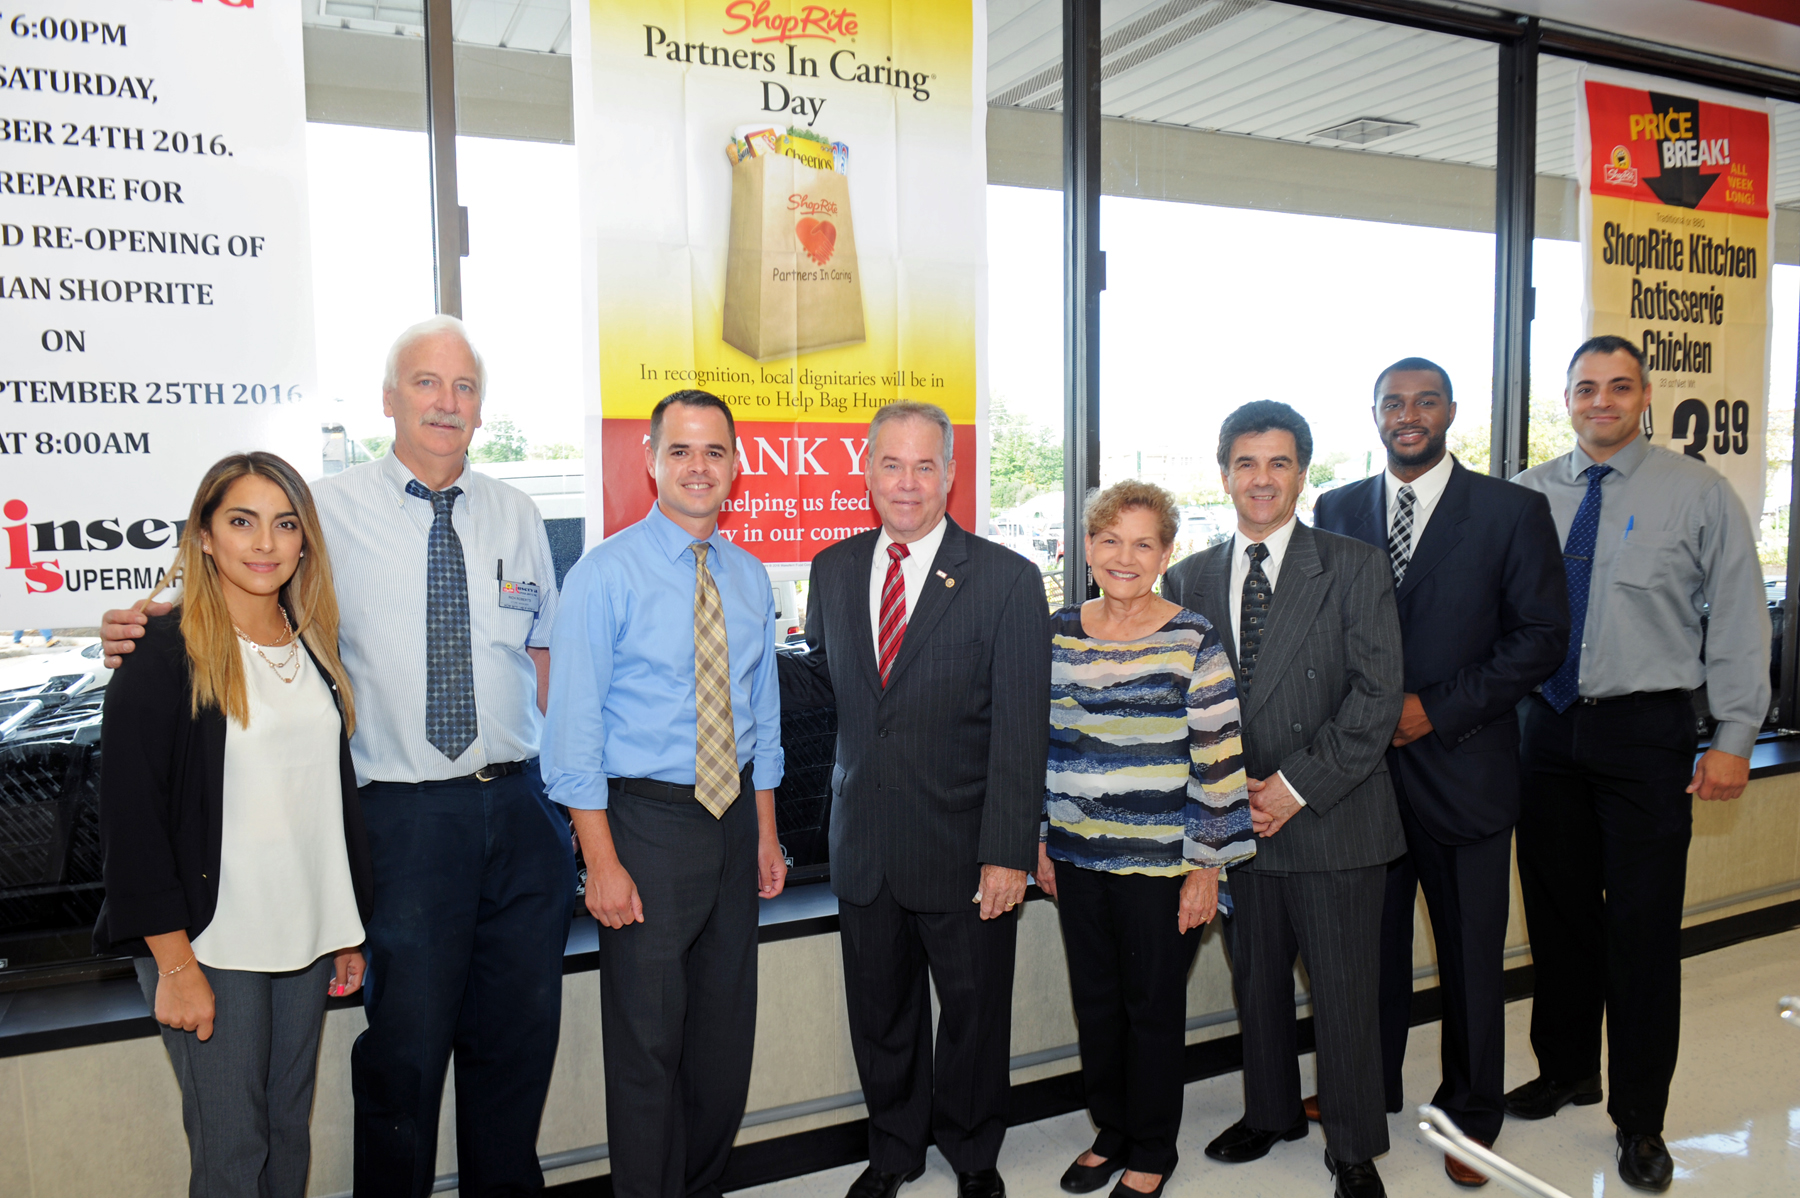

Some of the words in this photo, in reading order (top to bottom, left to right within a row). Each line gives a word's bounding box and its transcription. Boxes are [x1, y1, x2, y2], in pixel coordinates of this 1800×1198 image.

[10, 13, 128, 47] 6:00PM
[722, 0, 858, 43] ShopRite
[643, 24, 776, 72] Partners
[785, 43, 819, 78] In
[829, 49, 931, 101] Caring
[760, 80, 826, 126] Day
[61, 122, 145, 151] 24TH
[152, 129, 234, 157] 2016.
[1662, 138, 1731, 169] BREAK!
[1730, 163, 1748, 176] ALL
[123, 178, 185, 204] FOR
[1727, 176, 1754, 191] WEEK
[787, 193, 838, 215] ShopRite
[1726, 190, 1756, 205] LONG!
[31, 225, 220, 256] RE-OPENING
[227, 235, 265, 258] OF
[1603, 221, 1684, 275] ShopRite
[1689, 233, 1757, 279] Kitchen
[772, 267, 818, 281] Partners
[820, 268, 829, 281] In
[831, 268, 852, 283] Caring
[59, 277, 214, 306] SHOPRITE
[1630, 278, 1724, 326] Rotisserie
[41, 329, 86, 352] ON
[1643, 329, 1712, 374] Chicken
[640, 363, 658, 380] In
[664, 367, 755, 386] recognition,
[760, 367, 794, 384] local
[799, 368, 876, 390] dignitaries
[881, 371, 905, 386] will
[911, 371, 926, 387] be
[931, 373, 945, 388] in
[146, 382, 226, 404] 25TH
[232, 383, 303, 405] 2016
[756, 395, 770, 406] to
[776, 391, 814, 412] Help
[820, 391, 848, 413] Bag
[35, 432, 150, 454] 8:00AM
[803, 497, 824, 511] us
[829, 490, 871, 511] feed
[743, 523, 764, 542] in
[770, 527, 805, 541] our
